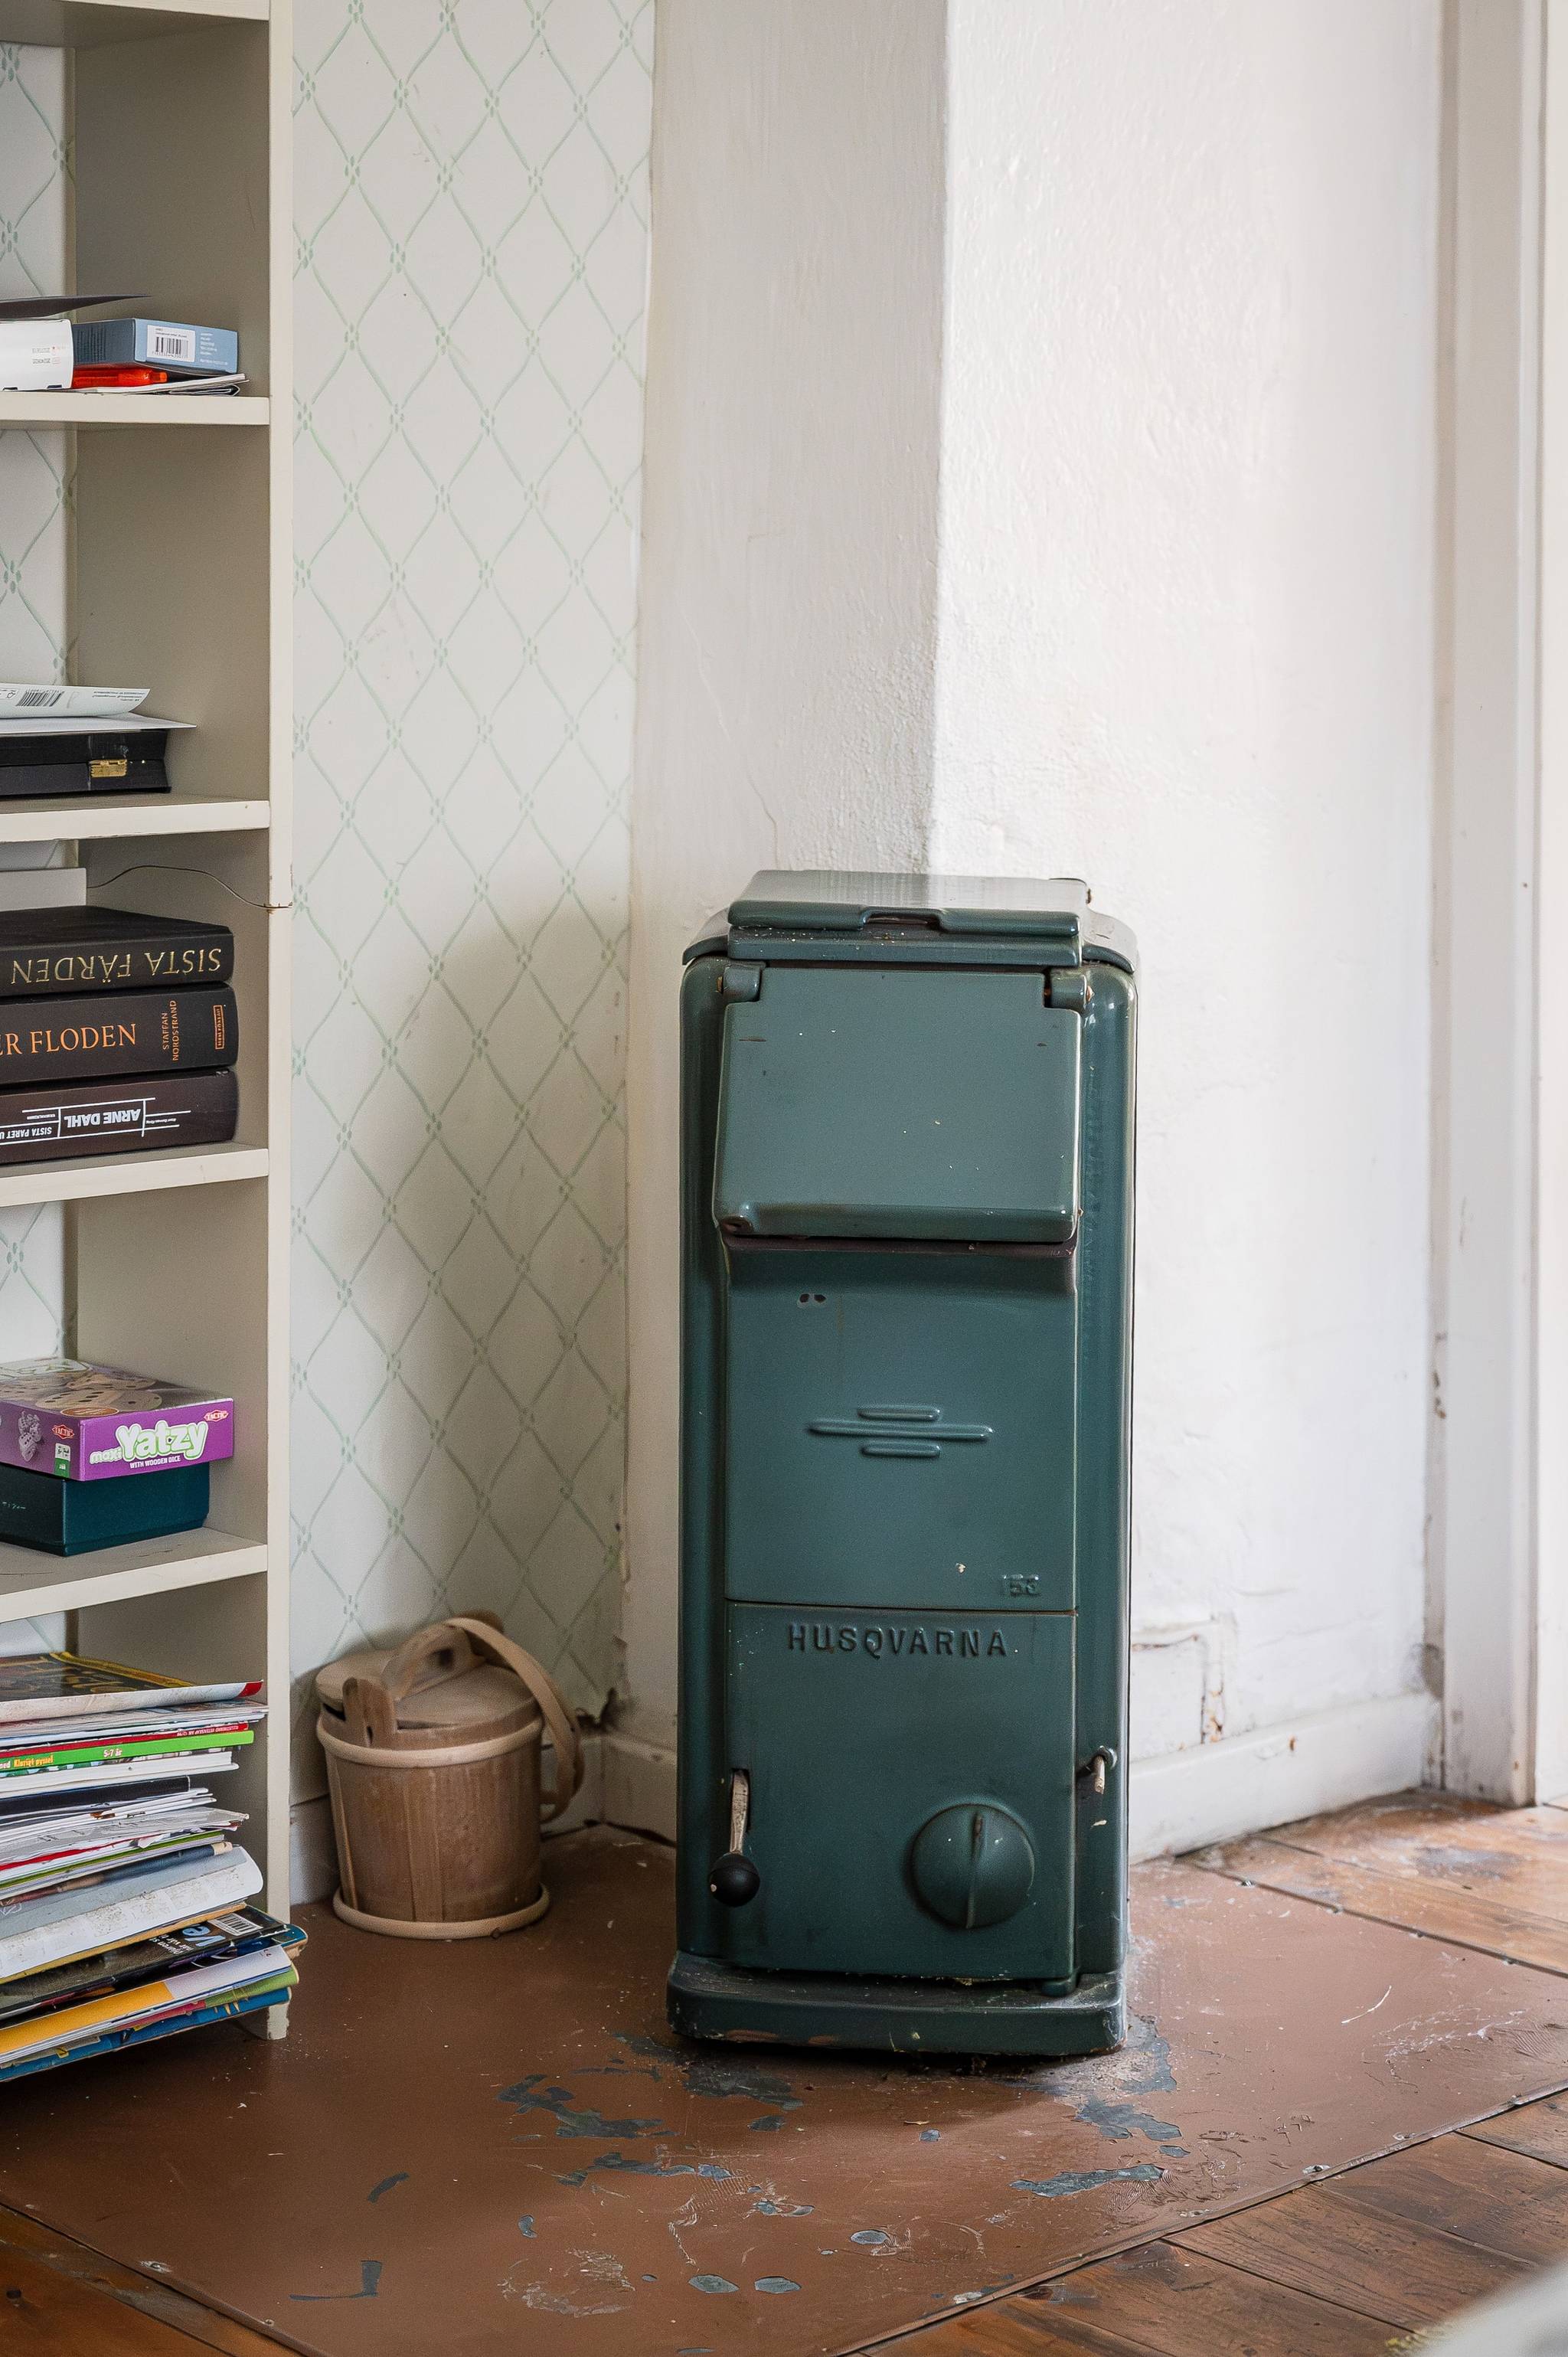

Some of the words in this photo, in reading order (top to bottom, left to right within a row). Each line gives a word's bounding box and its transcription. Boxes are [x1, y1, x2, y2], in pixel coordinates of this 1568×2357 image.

[11, 953, 132, 985] FÄRDEN
[145, 948, 222, 976] SISTA
[0, 1033, 22, 1057] R
[31, 1023, 136, 1054] FLODEN
[170, 999, 178, 1062] NORDSTRAND
[64, 1113, 101, 1129] DAHL
[103, 1108, 141, 1123] ARNE
[5, 1128, 30, 1139] PARET
[31, 1126, 53, 1137] SISTA
[116, 1420, 209, 1460] Yatzy
[129, 1460, 144, 1469] WITH
[145, 1458, 168, 1468] WOODEN
[168, 1455, 181, 1465] DICE
[786, 1621, 1008, 1660] HUSQVARNA
